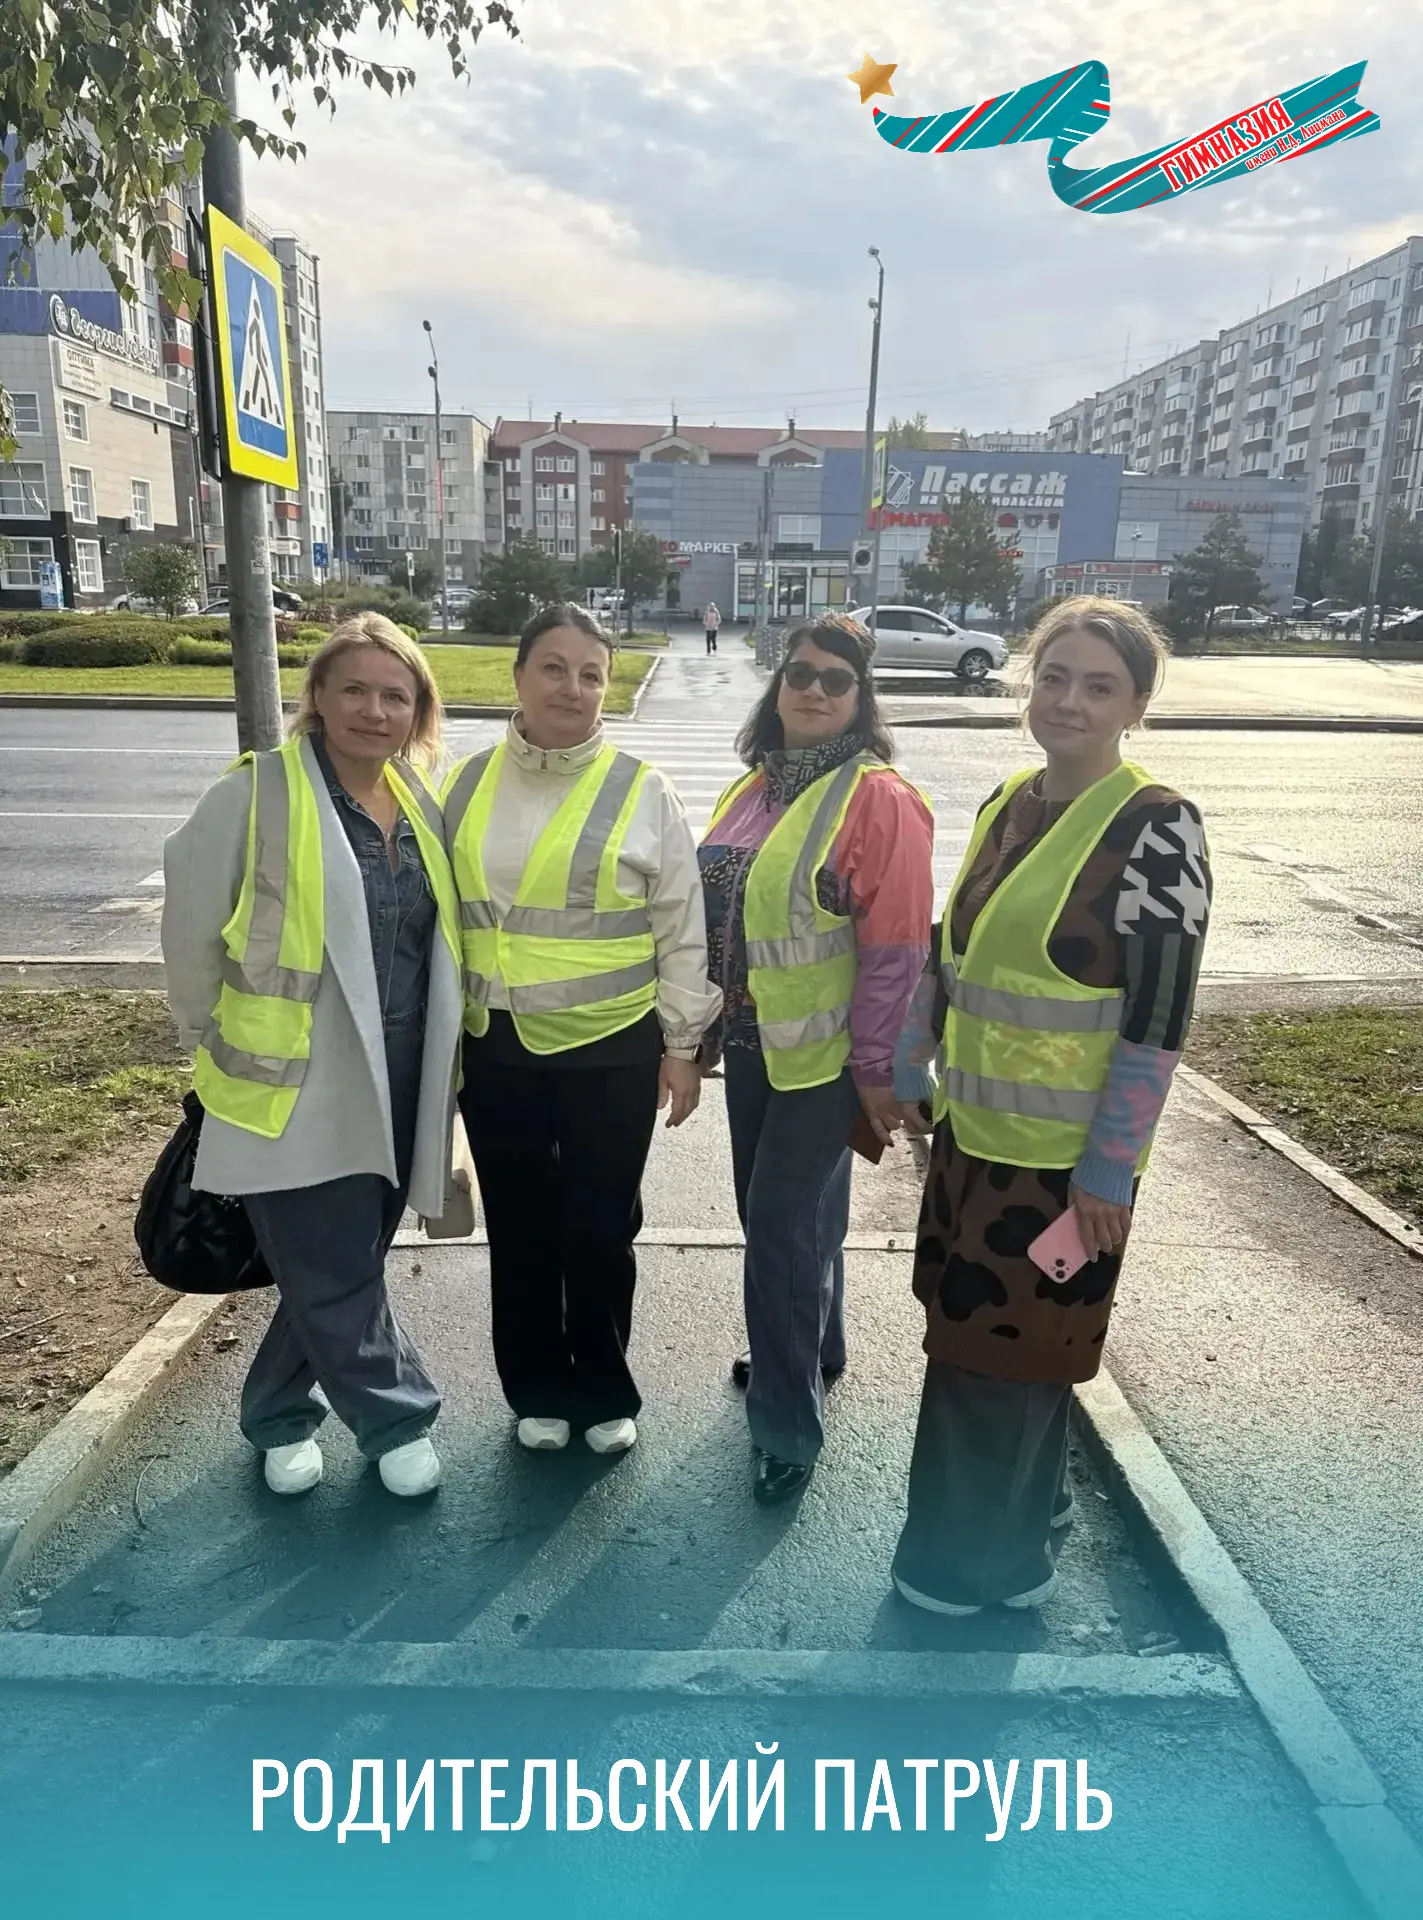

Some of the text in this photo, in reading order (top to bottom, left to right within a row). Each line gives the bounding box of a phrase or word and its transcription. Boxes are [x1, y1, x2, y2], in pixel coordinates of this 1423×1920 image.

[919, 464, 1069, 496] Пассаж
[919, 494, 1065, 508] на мольском
